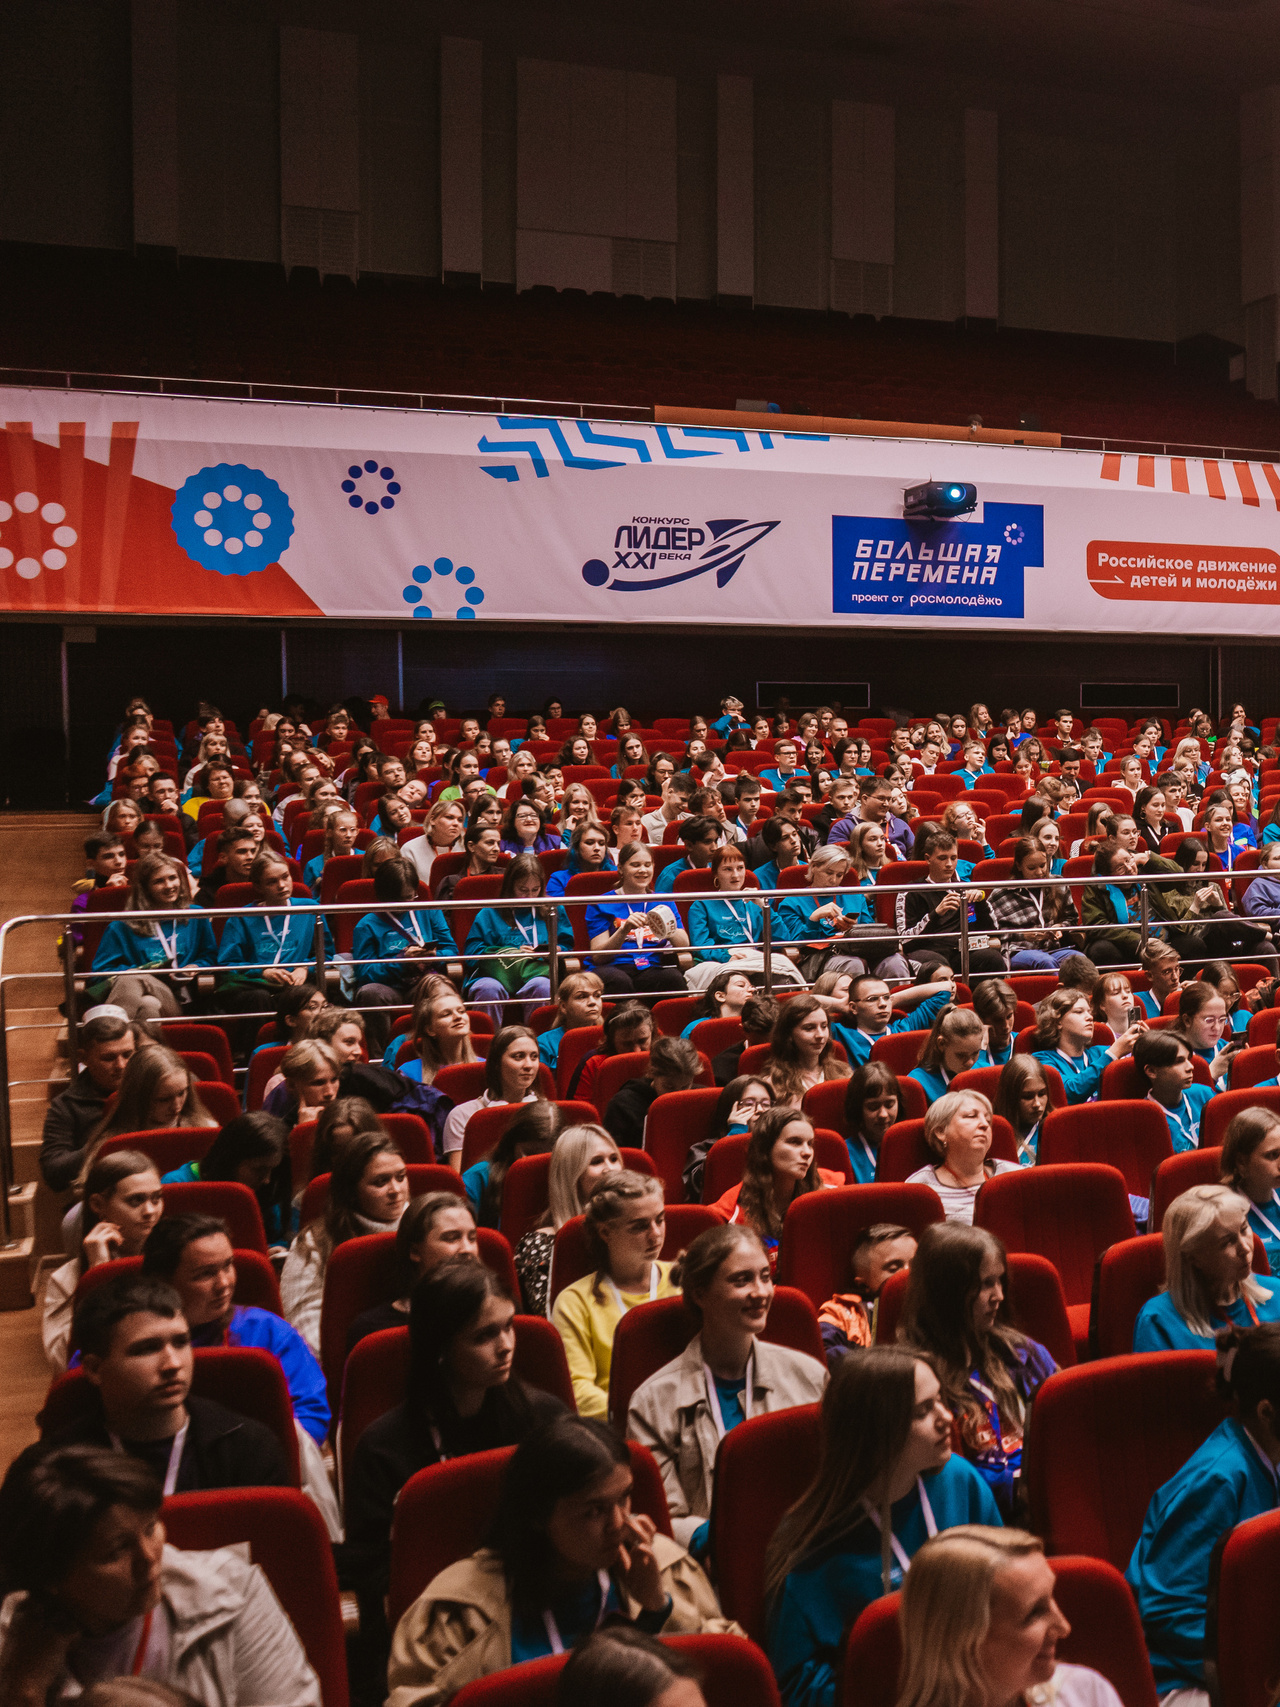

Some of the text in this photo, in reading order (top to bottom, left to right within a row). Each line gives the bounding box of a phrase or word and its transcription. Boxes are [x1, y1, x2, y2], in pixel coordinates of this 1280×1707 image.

[632, 516, 690, 526] КОНКУРС
[614, 525, 706, 551] ЛИДЕР
[658, 552, 692, 561] ВЕКА
[855, 538, 1002, 564] БОЛЬШАЯ
[851, 561, 998, 585] ПЕРЕМЕНА
[1097, 552, 1277, 574] Российское движение
[1130, 573, 1278, 592] детей и молодёжи
[851, 593, 1003, 608] проект от росмолодёжь
